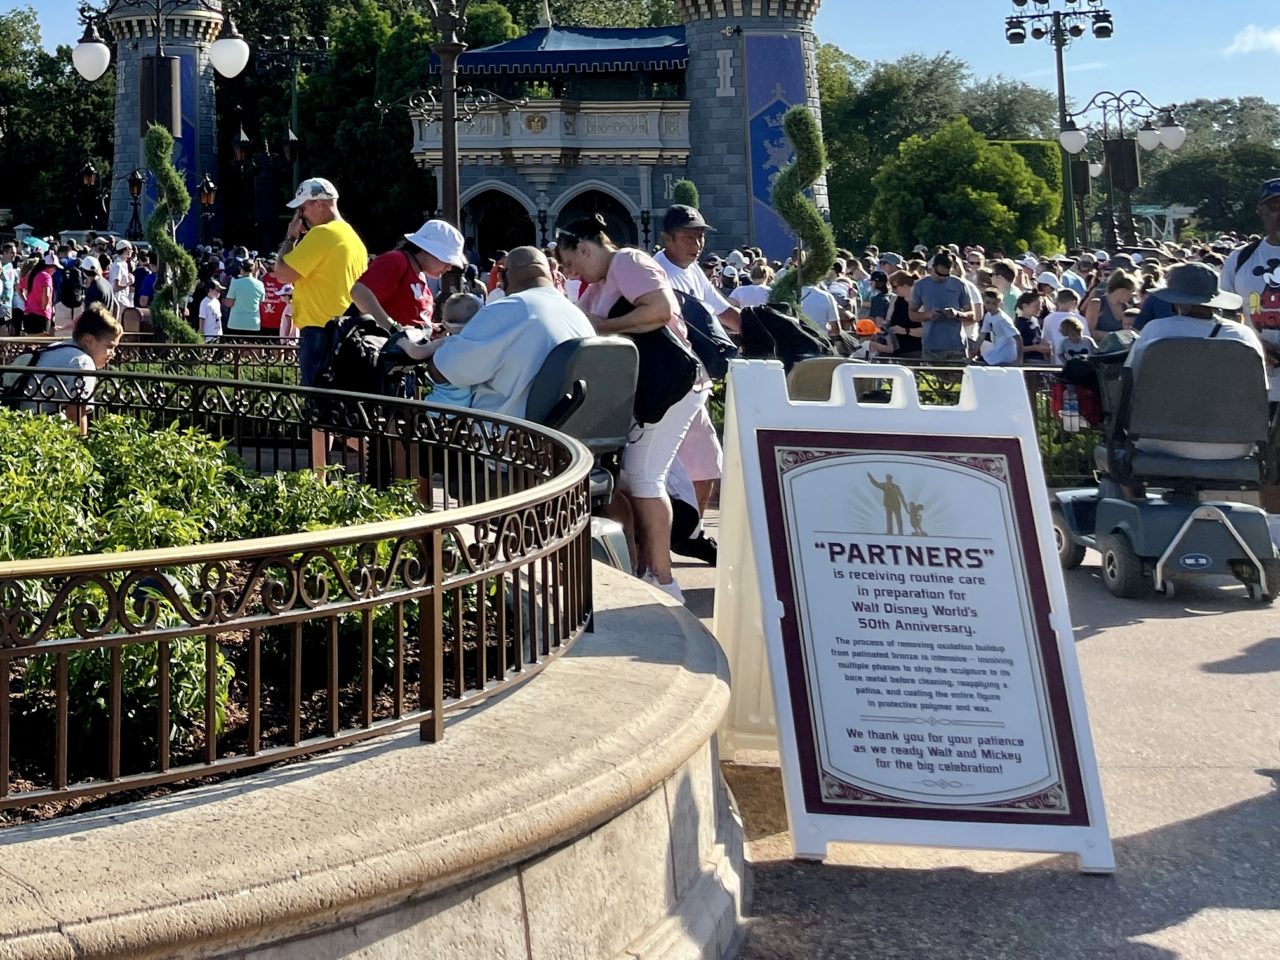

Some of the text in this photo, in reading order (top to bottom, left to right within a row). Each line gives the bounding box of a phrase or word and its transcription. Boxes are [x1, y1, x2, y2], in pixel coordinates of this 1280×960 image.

[833, 568, 986, 585] is receiving routine care
[857, 585, 967, 601] in preparation for
[851, 601, 978, 619] Walt Disney World's
[858, 618, 977, 638] 50th Anniversary.
[835, 636, 850, 645] The
[852, 639, 884, 647] process
[897, 641, 934, 651] removing
[830, 648, 849, 657] from
[871, 663, 901, 672] phases
[934, 666, 947, 674] the
[949, 667, 987, 676] sculpture
[844, 674, 863, 682] bare
[865, 675, 888, 683] metal
[889, 675, 915, 684] before
[935, 690, 949, 698] the
[878, 700, 918, 709] protective
[846, 727, 1025, 747] We thank you for your patience
[852, 744, 1022, 764] as we ready Walt and Mickey
[875, 758, 1003, 774] for the big celebration!
